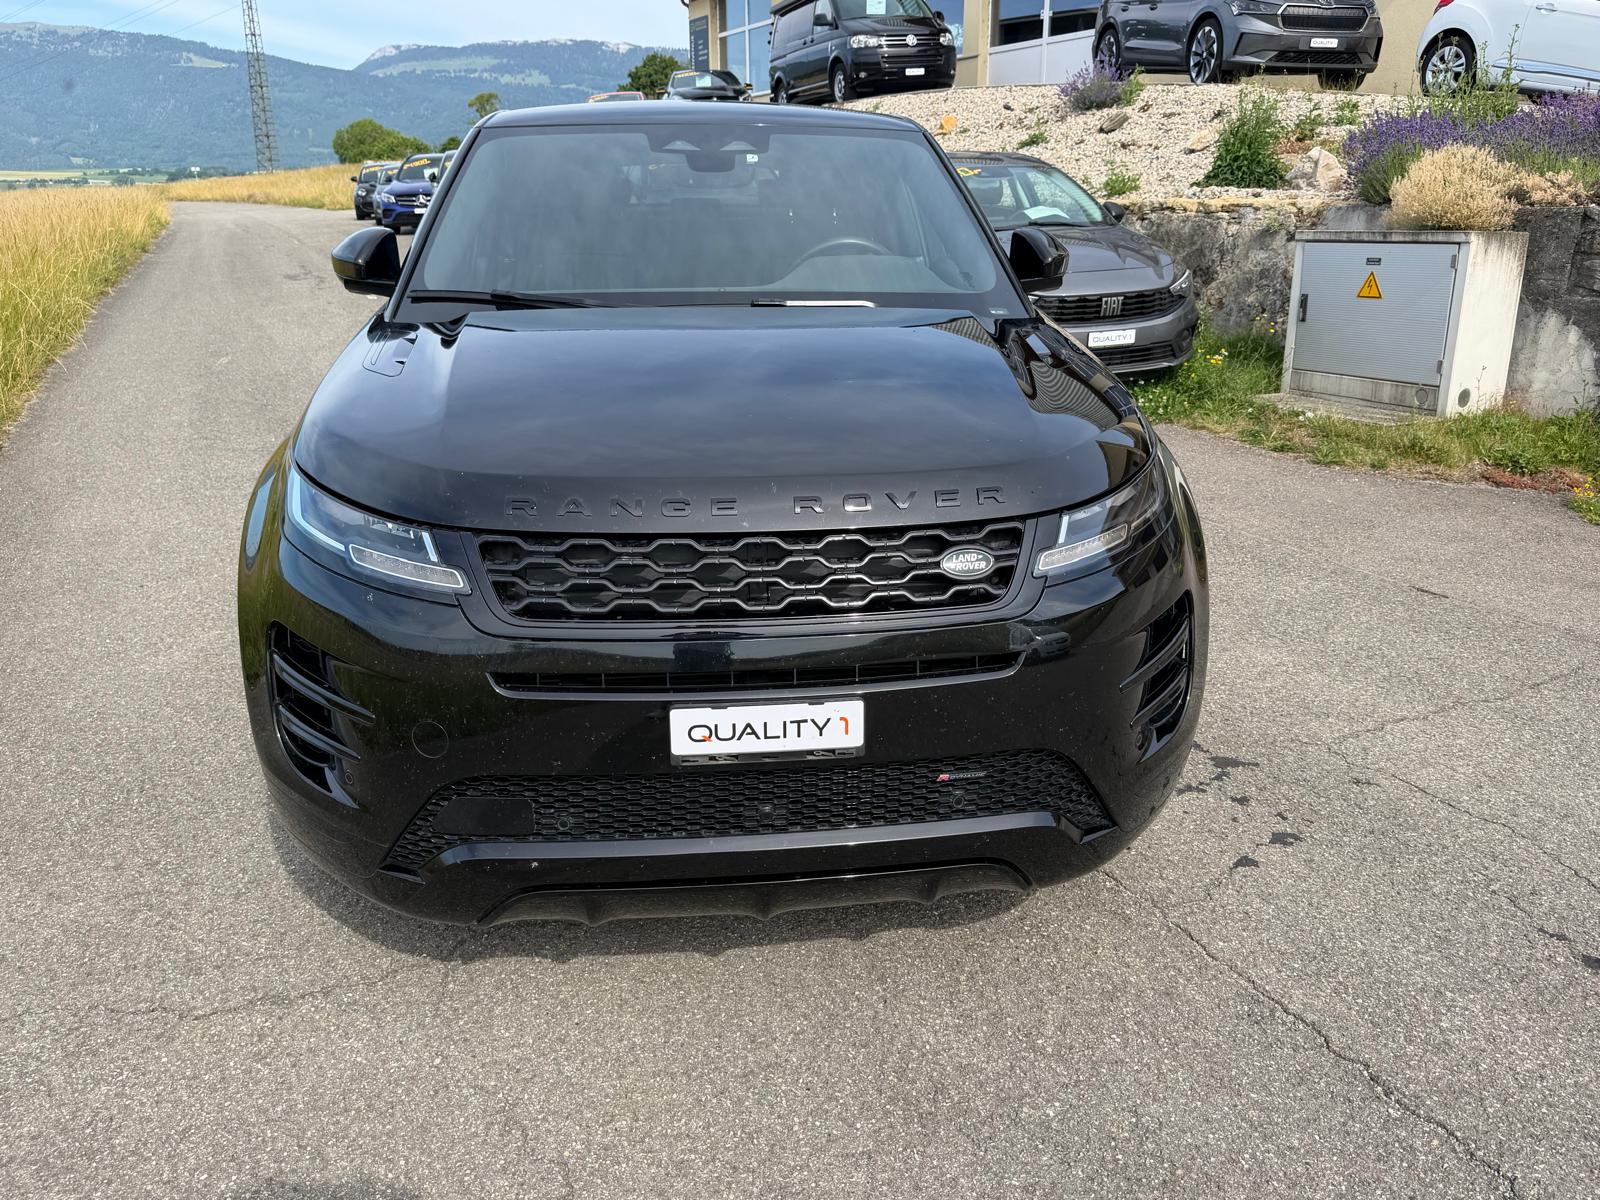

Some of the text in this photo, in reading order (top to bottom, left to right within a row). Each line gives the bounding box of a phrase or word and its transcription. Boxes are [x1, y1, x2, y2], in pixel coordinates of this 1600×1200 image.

[1100, 296, 1124, 317] FIAT
[1092, 334, 1128, 343] QUALITY
[504, 486, 1006, 518] RANGE ROVER
[952, 553, 977, 563] LAND
[955, 561, 986, 571] ROVER
[687, 716, 850, 743] QUALITY 1
